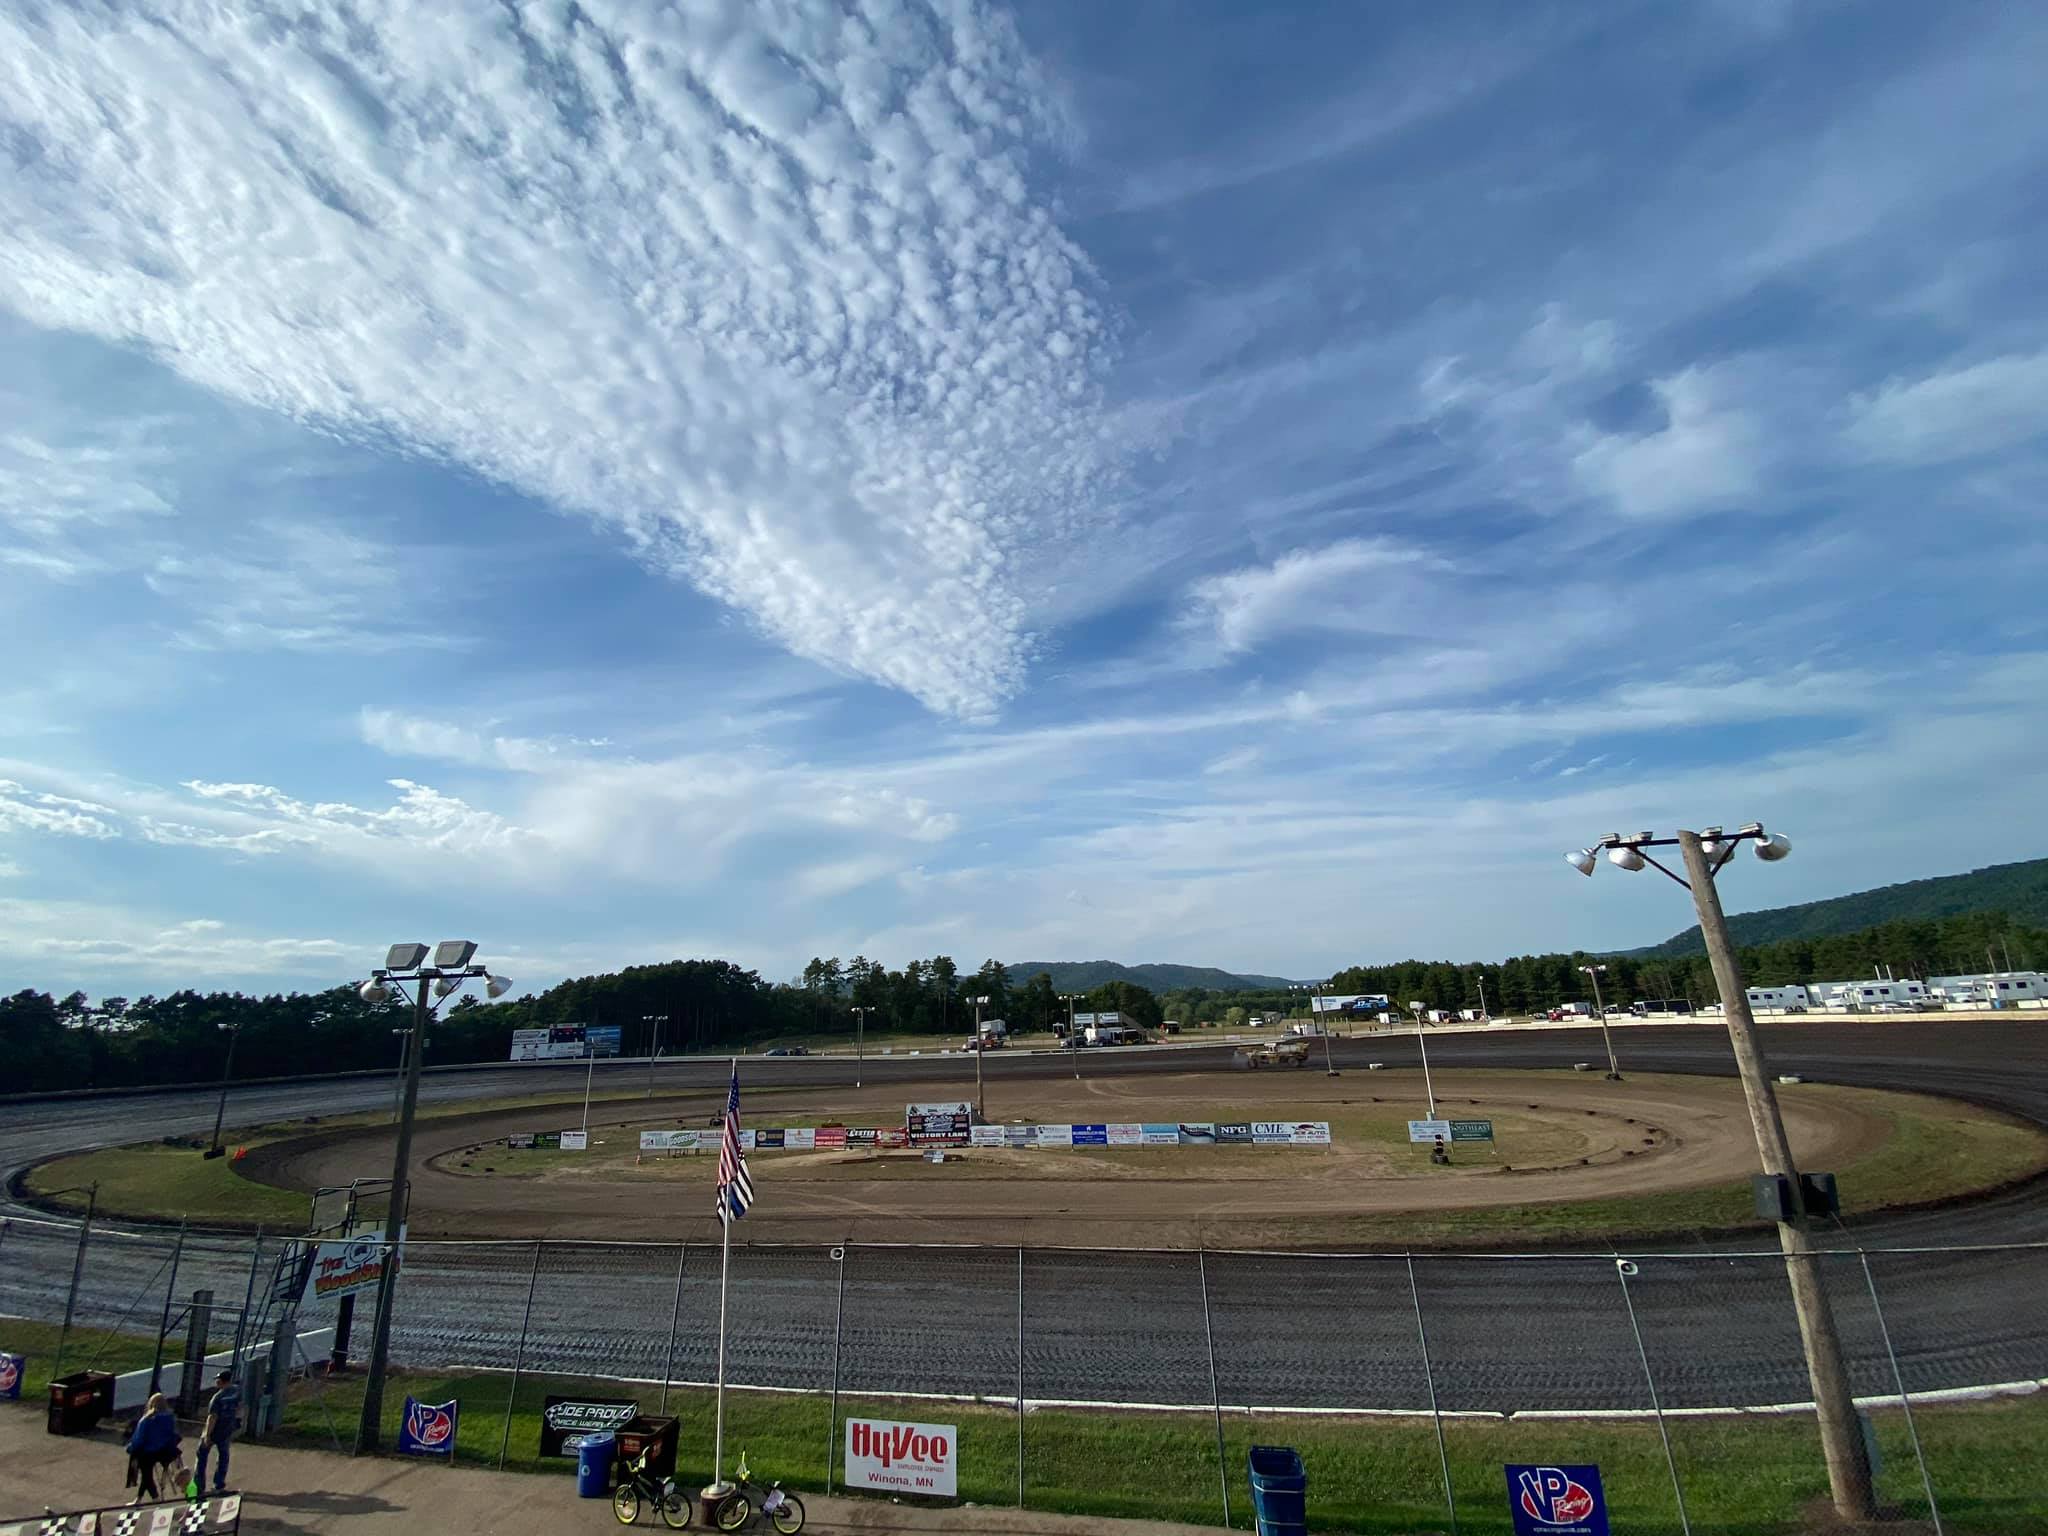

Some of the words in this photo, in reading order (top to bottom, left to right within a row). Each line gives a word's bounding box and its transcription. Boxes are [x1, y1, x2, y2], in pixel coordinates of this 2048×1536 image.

[1220, 1126, 1247, 1134] NPG
[557, 1405, 586, 1417] JOE
[868, 1471, 912, 1487] Winona,
[915, 1476, 934, 1487] MN
[1518, 1467, 1570, 1523] VP
[1555, 1496, 1591, 1518] Racing
